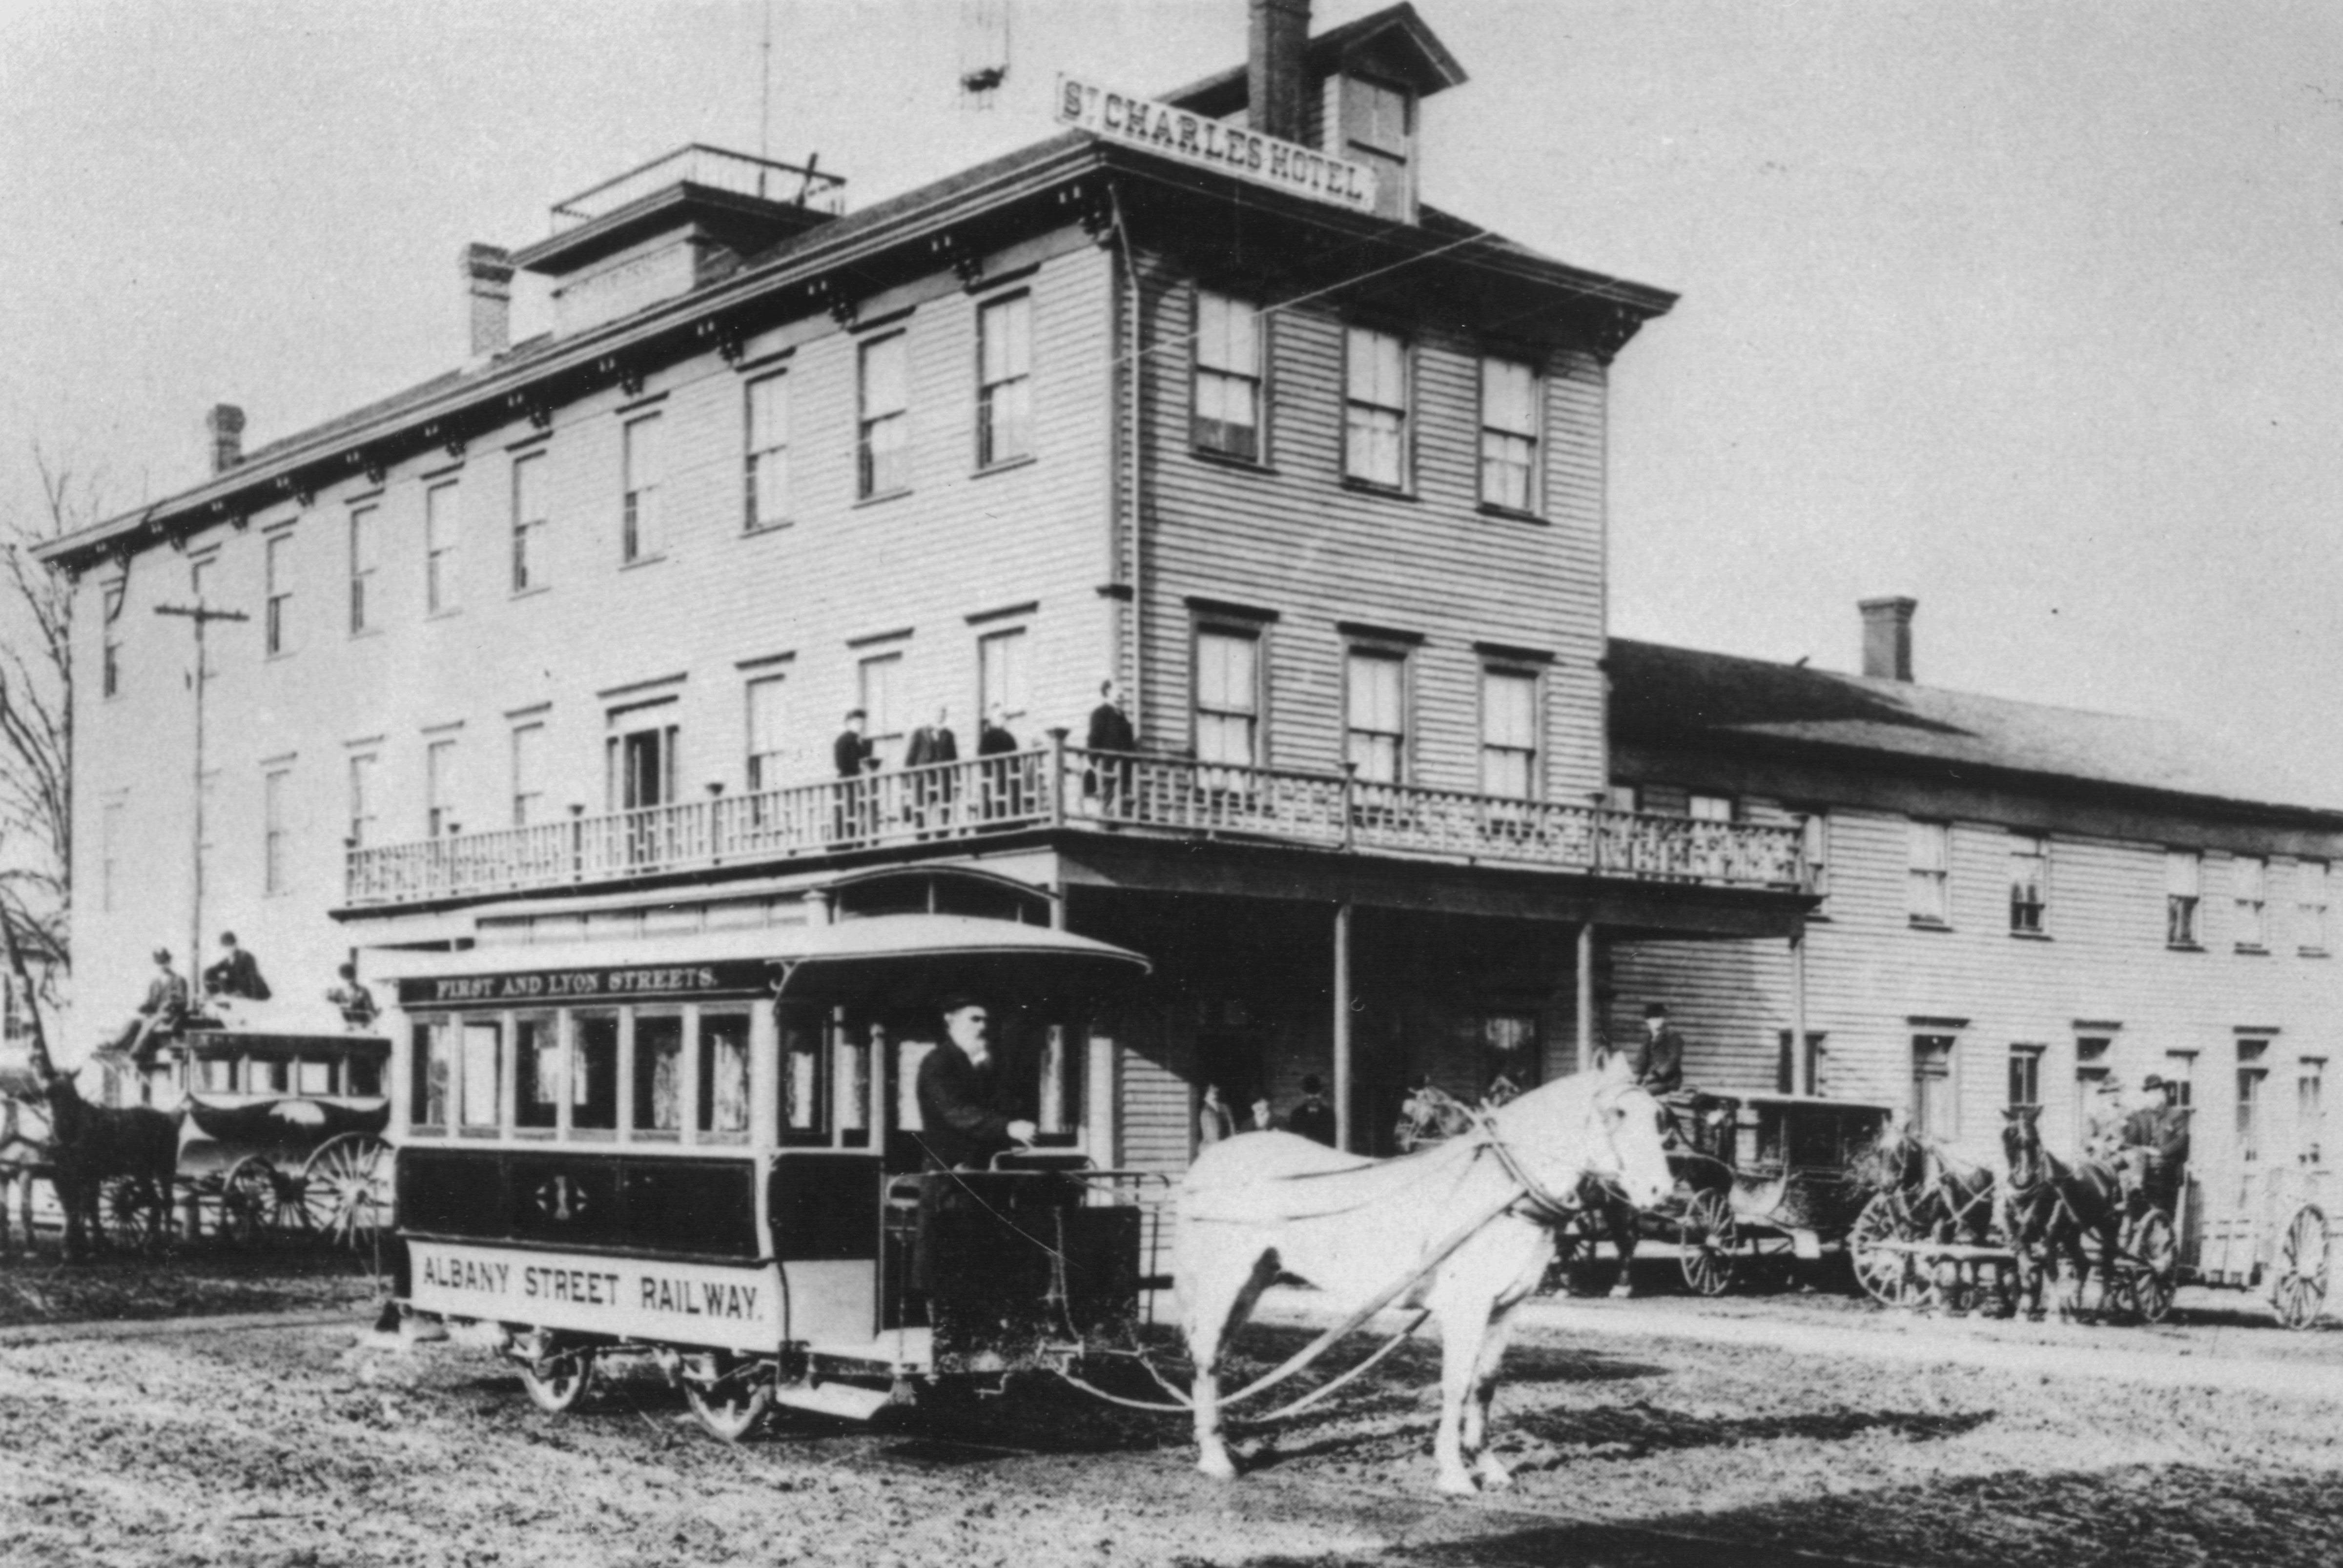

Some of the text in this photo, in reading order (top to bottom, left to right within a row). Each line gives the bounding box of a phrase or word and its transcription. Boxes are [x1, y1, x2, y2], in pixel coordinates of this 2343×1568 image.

[1105, 93, 1261, 170] CHARLES
[1270, 143, 1362, 200] HOTEL
[437, 978, 494, 999] FIRST
[501, 976, 542, 996] AND
[548, 973, 599, 994] LYON
[424, 1257, 763, 1320] ALBANY STREET RAILWAY.
